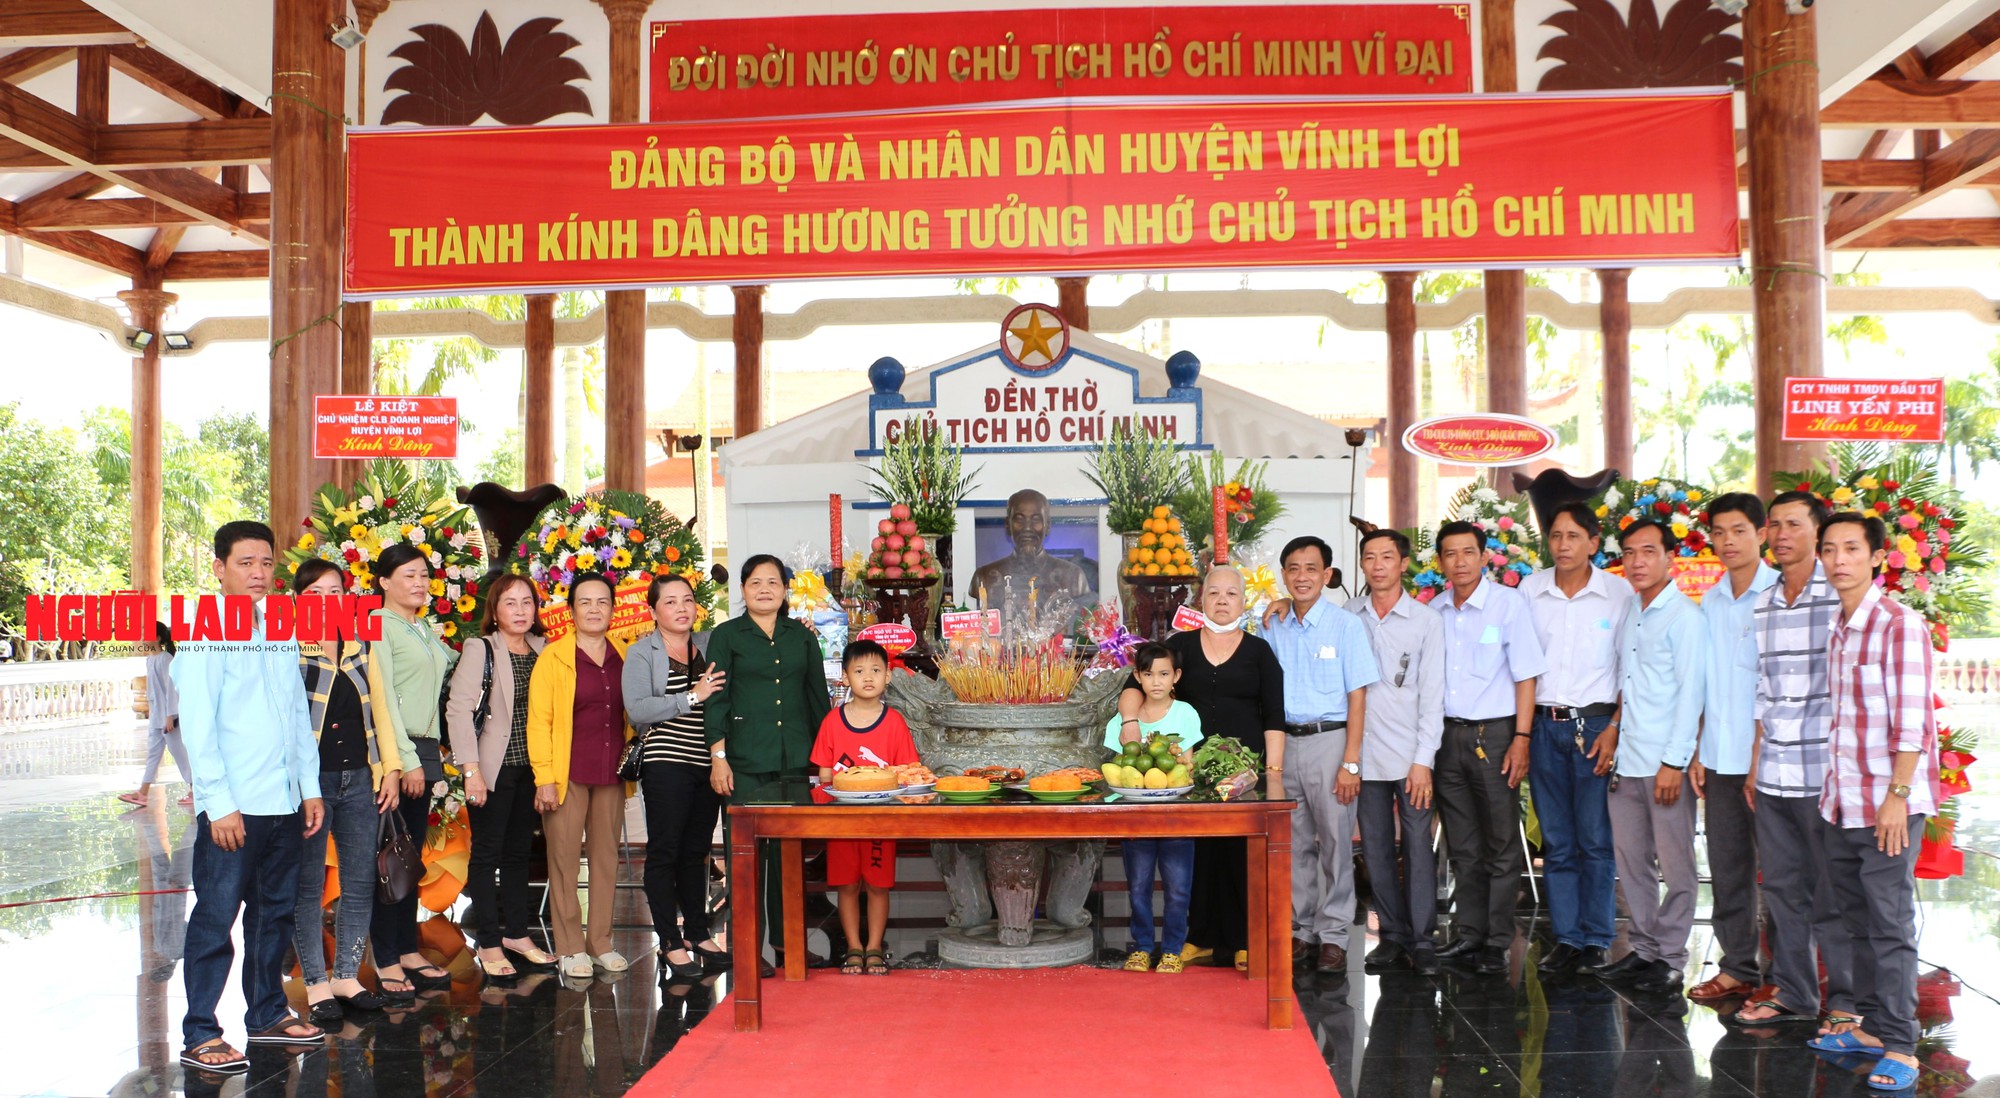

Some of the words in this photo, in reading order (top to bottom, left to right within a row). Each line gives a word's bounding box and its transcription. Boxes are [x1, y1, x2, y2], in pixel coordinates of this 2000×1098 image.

[668, 46, 726, 91] ĐỜI
[736, 43, 795, 89] ĐỜI
[806, 40, 878, 86] NHỚ
[889, 42, 937, 84] ƠN
[948, 32, 1021, 82] CHỦ
[1031, 43, 1112, 88] TỊCH
[1124, 27, 1172, 78] HỒ
[1183, 32, 1241, 77] CHÍ
[1253, 40, 1342, 76] MINH
[1352, 32, 1386, 75] VĨ
[1395, 40, 1453, 84] ĐẠI
[609, 136, 725, 189] ĐẢNG
[740, 136, 796, 193] BỘ
[810, 133, 865, 182] VÀ
[879, 129, 1000, 180] NHÂN
[1015, 126, 1105, 176] DÂN
[1120, 122, 1263, 181] HUYỆN
[1277, 121, 1380, 170] VĨNH
[1394, 123, 1460, 177] LỢI
[389, 215, 524, 267] THÀNH
[538, 213, 638, 262] KÍNH
[652, 208, 768, 258] DÂNG
[783, 206, 930, 254] HƯƠNG
[943, 193, 1089, 249] TƯỞNG
[1103, 194, 1195, 246] NHỚ
[1208, 187, 1296, 243] CHỦ
[1309, 198, 1407, 250] TỊCH
[1421, 183, 1479, 238] HỒ
[1493, 186, 1565, 237] CHÍ
[1579, 193, 1695, 235] MINH
[984, 378, 1036, 413] ĐỀN
[1043, 378, 1098, 413] THỜ
[1792, 383, 1814, 394] CTY
[1818, 384, 1850, 394] TNHH
[1853, 384, 1887, 394] TMDV
[1890, 381, 1916, 394] ĐẦU
[1919, 383, 1937, 394] TƯ
[354, 399, 375, 411] LÊ
[380, 399, 418, 414] KIỆT
[1791, 400, 1841, 414] LINH
[1847, 395, 1891, 414] YẾN
[1897, 401, 1935, 415] PHI
[318, 413, 336, 424] CHỦ
[339, 414, 367, 425] NHIỆM
[370, 415, 387, 424] CLB
[390, 415, 420, 424] DOANH
[423, 415, 456, 426] NGHIỆP
[947, 418, 1008, 447] TỊCH
[1016, 406, 1051, 443] HỒ
[1060, 408, 1106, 442] CHÍ
[1112, 415, 1177, 440] MNH
[1807, 416, 1858, 432] Kính
[1864, 416, 1917, 438] Dâng
[351, 425, 381, 436] HUYỆN
[384, 426, 404, 435] VĨNH
[407, 426, 422, 436] LỢI
[339, 436, 382, 451] Kính
[388, 436, 433, 456] Dâng
[1435, 442, 1473, 451] Kính
